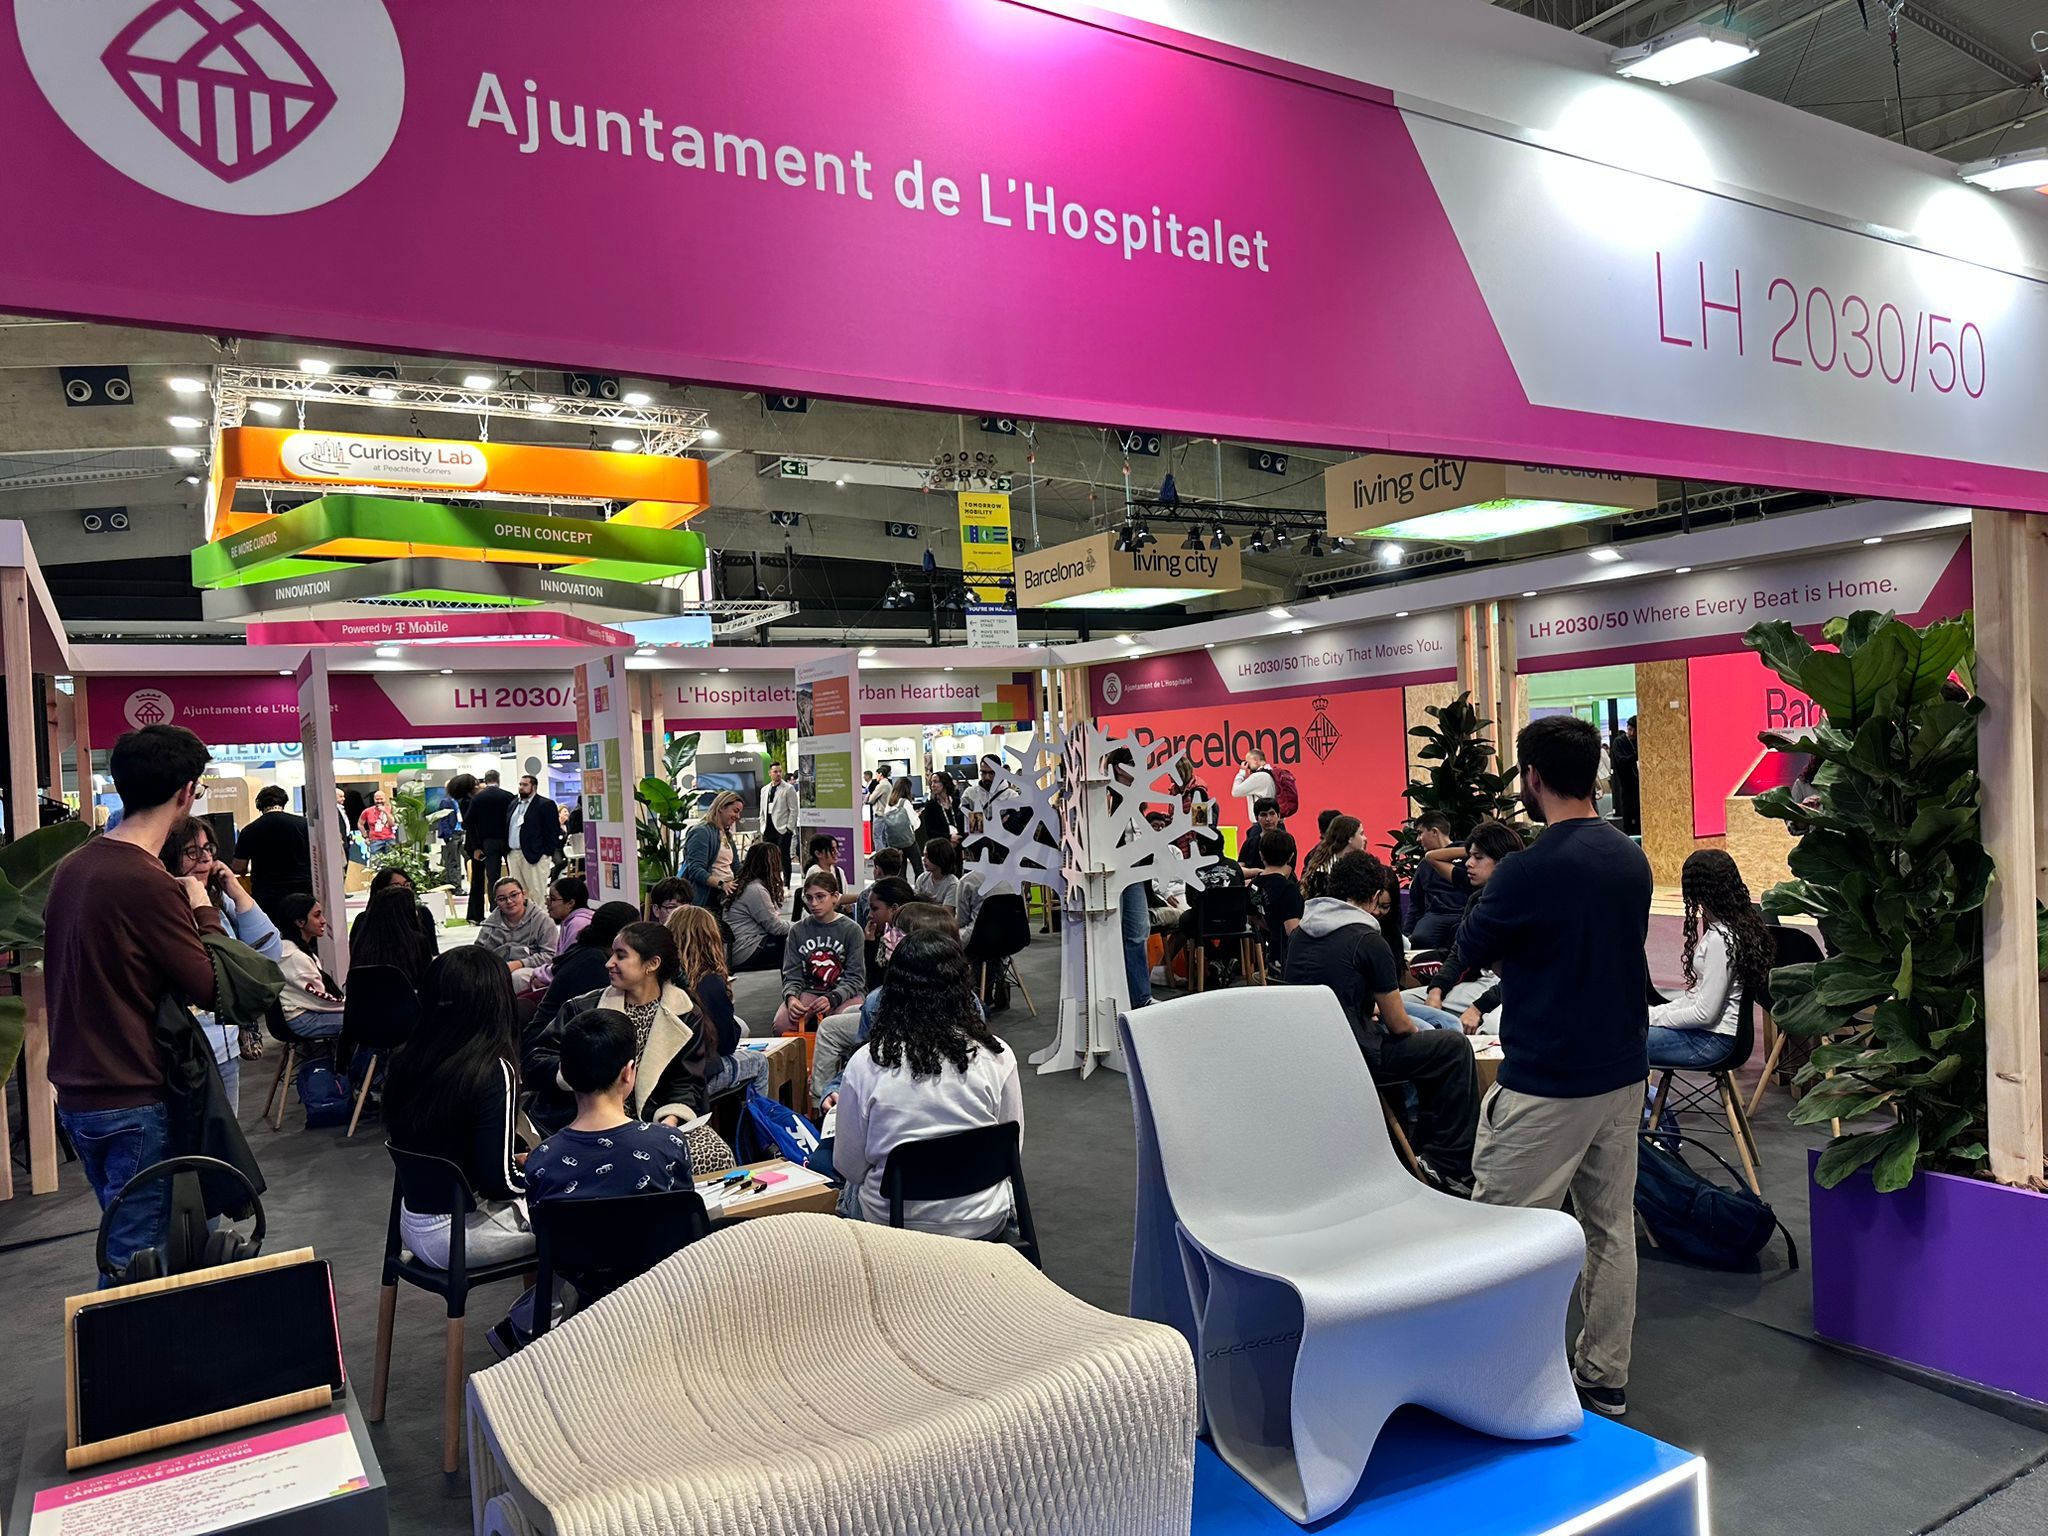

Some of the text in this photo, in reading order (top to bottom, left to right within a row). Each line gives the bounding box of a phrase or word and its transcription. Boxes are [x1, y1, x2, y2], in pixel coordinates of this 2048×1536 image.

[466, 71, 1270, 273] Ajuntament de L'Hospitalet
[1655, 251, 1986, 399] LH 2030/50
[348, 443, 473, 466] Curiosity Lab
[383, 464, 421, 474] Peachtree
[422, 467, 452, 476] Corners
[1352, 458, 1468, 509] living city
[230, 530, 278, 558] BE MORE CURIOUS
[494, 523, 594, 545] OPEN CONCEPT
[1024, 560, 1084, 590] Barcelona
[1132, 550, 1219, 578] living city
[275, 580, 331, 601] INNOVATION
[540, 577, 604, 599] INNOVATION
[1529, 575, 1899, 639] LH 2030/50 Where Every Beat is Home.
[341, 623, 380, 636] Powered
[381, 622, 393, 636] by
[407, 620, 449, 634] Mobile
[1238, 637, 1444, 677] LH 2030/50 The City That Moves You.
[677, 684, 797, 706] L'Hospitalet:
[858, 683, 896, 701] rban
[900, 683, 981, 700] Heartbeat
[1124, 676, 1194, 693] Ajuntament de L'Hospitalet
[454, 686, 578, 709] LH 2030/
[182, 704, 252, 717] Ajuntament
[254, 704, 269, 714] de
[63, 1469, 166, 1501] LARGE-SCALE
[187, 1447, 254, 1471] PRINTING
